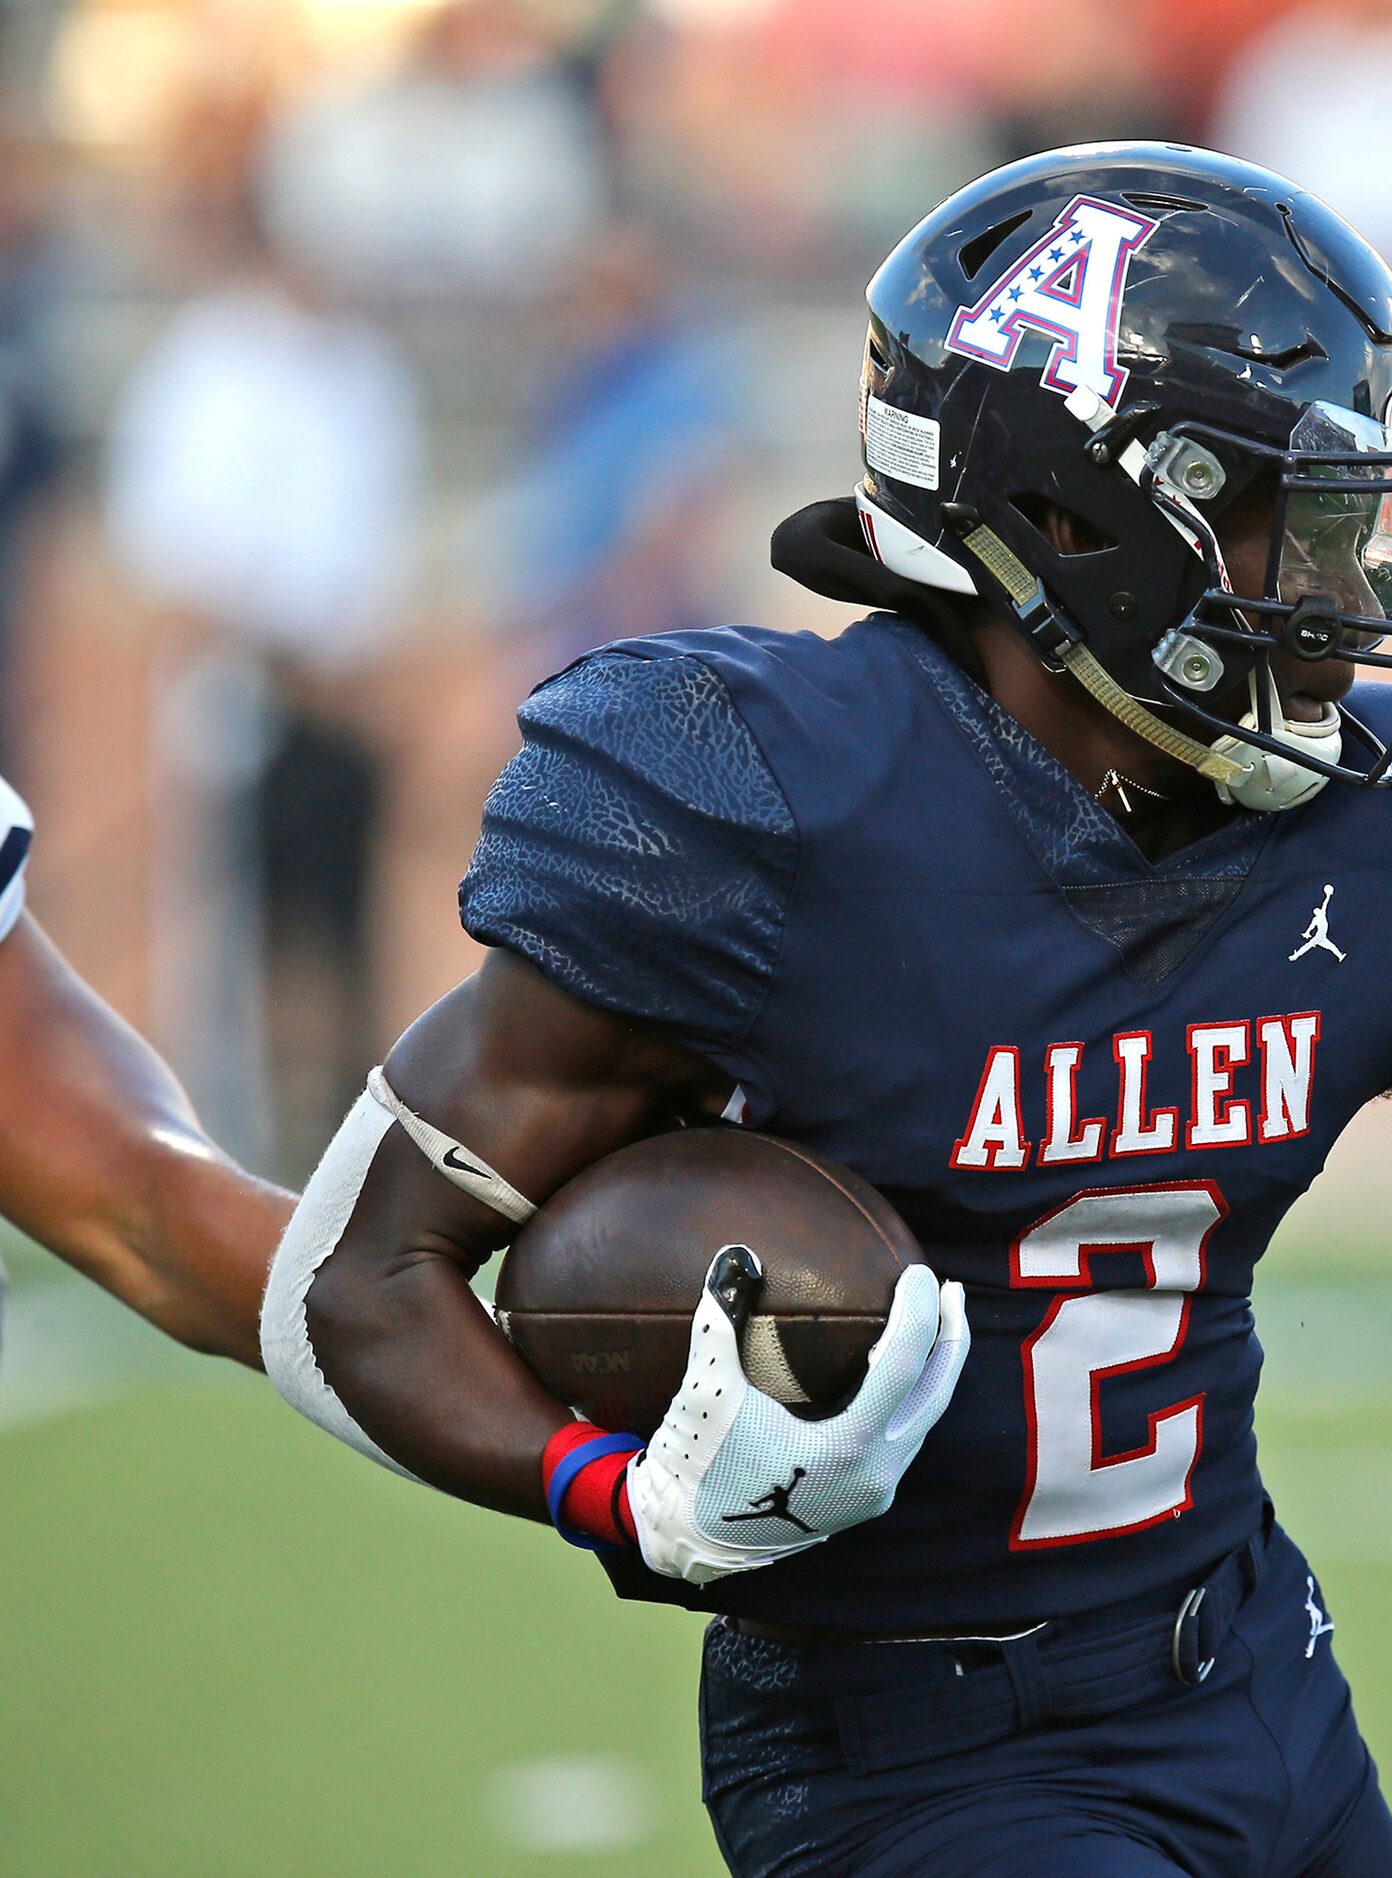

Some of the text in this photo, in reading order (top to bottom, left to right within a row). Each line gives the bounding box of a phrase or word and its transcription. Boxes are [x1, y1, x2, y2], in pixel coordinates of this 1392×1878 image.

[945, 194, 1161, 408] A
[948, 1010, 1322, 1172] ALLEN
[1008, 1178, 1230, 1551] 2
